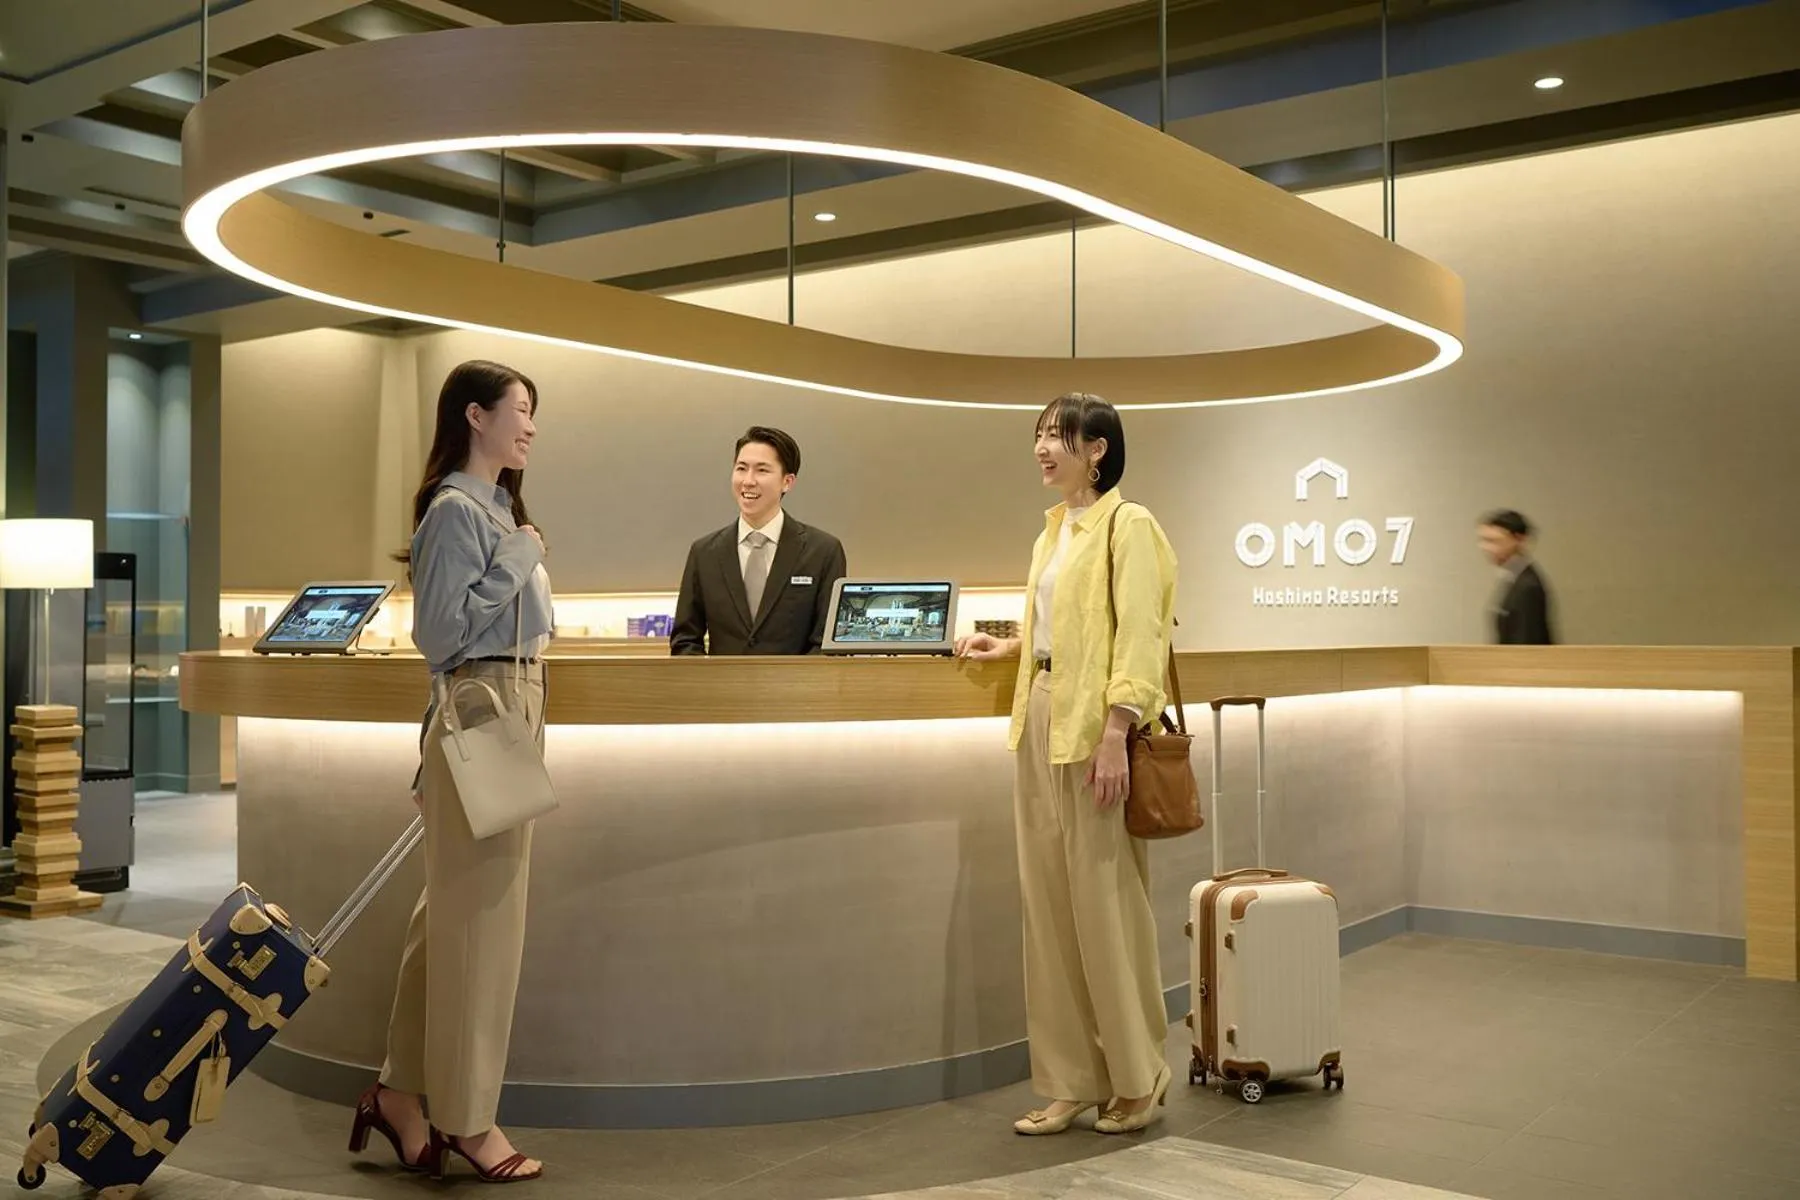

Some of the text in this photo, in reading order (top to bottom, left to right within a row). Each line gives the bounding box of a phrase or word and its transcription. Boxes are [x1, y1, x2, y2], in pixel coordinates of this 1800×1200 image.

[1234, 516, 1415, 568] OMO7
[1252, 585, 1399, 605] Hoshino Resorts
